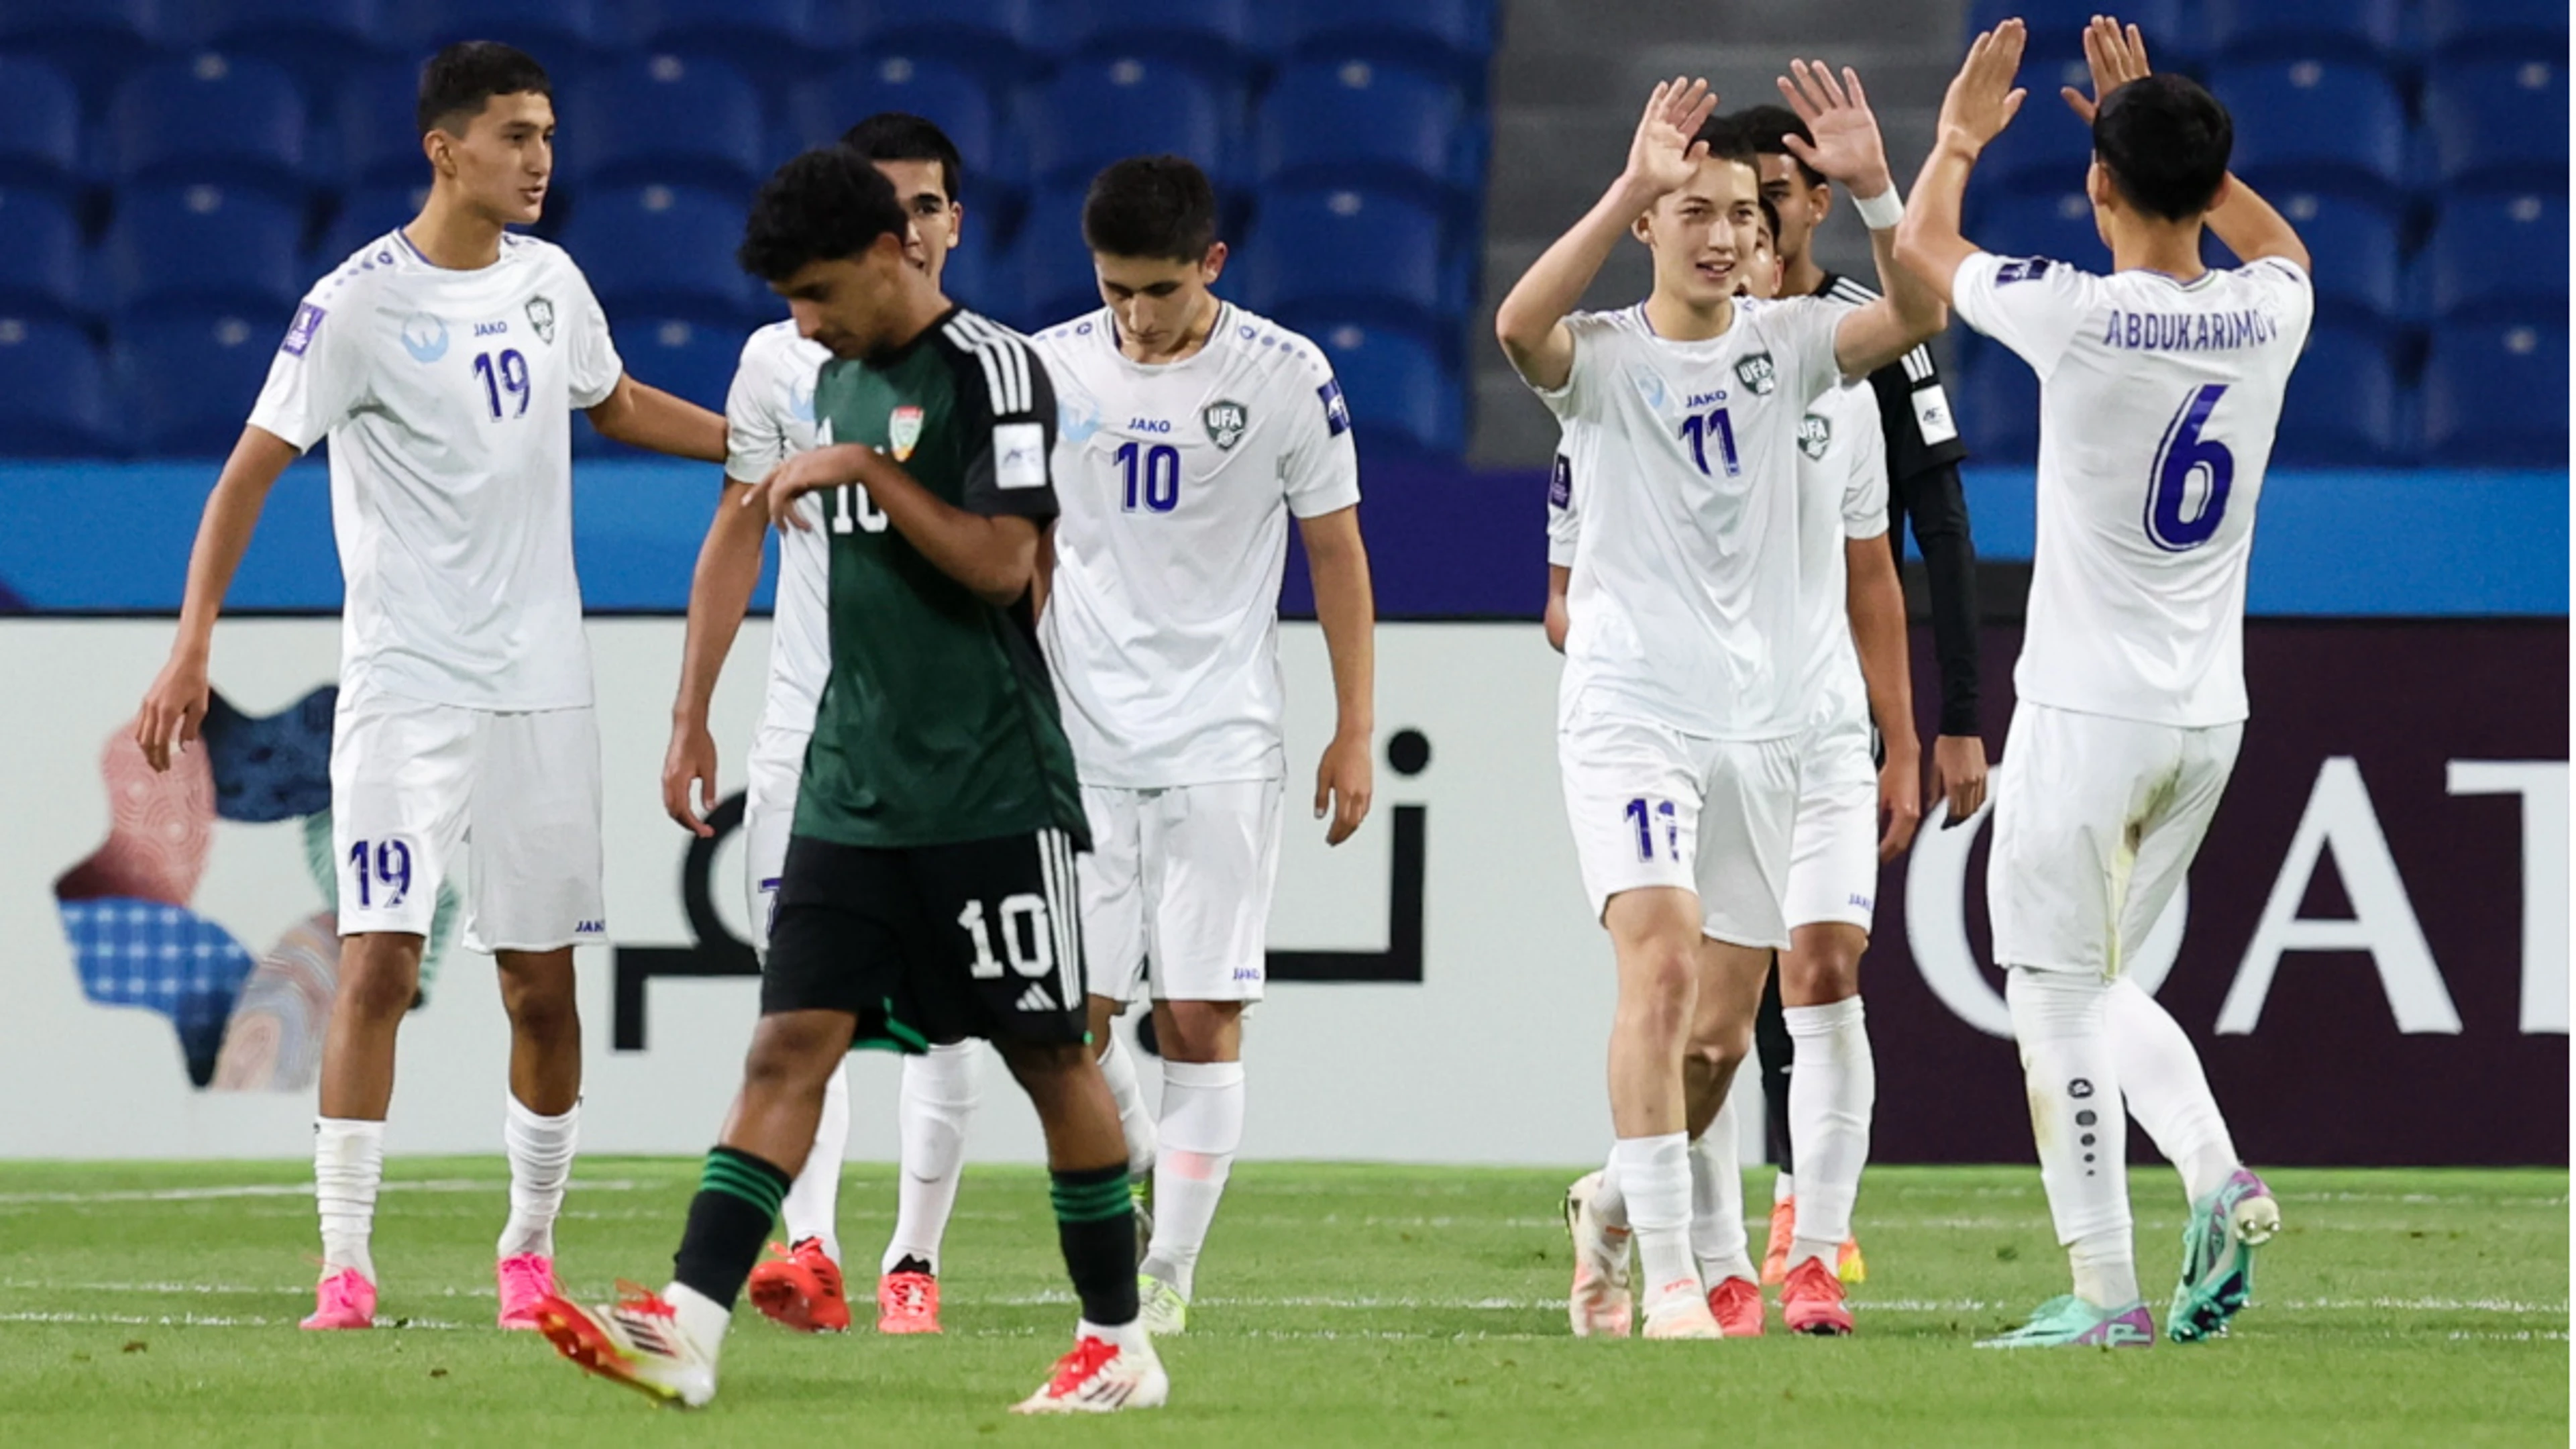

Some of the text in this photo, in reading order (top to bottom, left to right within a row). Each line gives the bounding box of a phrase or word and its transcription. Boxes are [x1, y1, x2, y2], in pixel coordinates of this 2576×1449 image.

[474, 321, 506, 335] JAKO
[2104, 310, 2277, 350] ABDUKARIMOV
[472, 347, 529, 422] 19
[1687, 390, 1726, 407] JAKO
[1739, 357, 1774, 384] UFA
[1128, 417, 1171, 433] JAKO
[1210, 409, 1242, 428] UFA
[1680, 408, 1739, 477] 11
[1112, 441, 1180, 512] 10
[2143, 384, 2234, 553] 6
[1623, 798, 1680, 863] 11
[348, 838, 413, 910] 19
[957, 894, 1053, 978] 10
